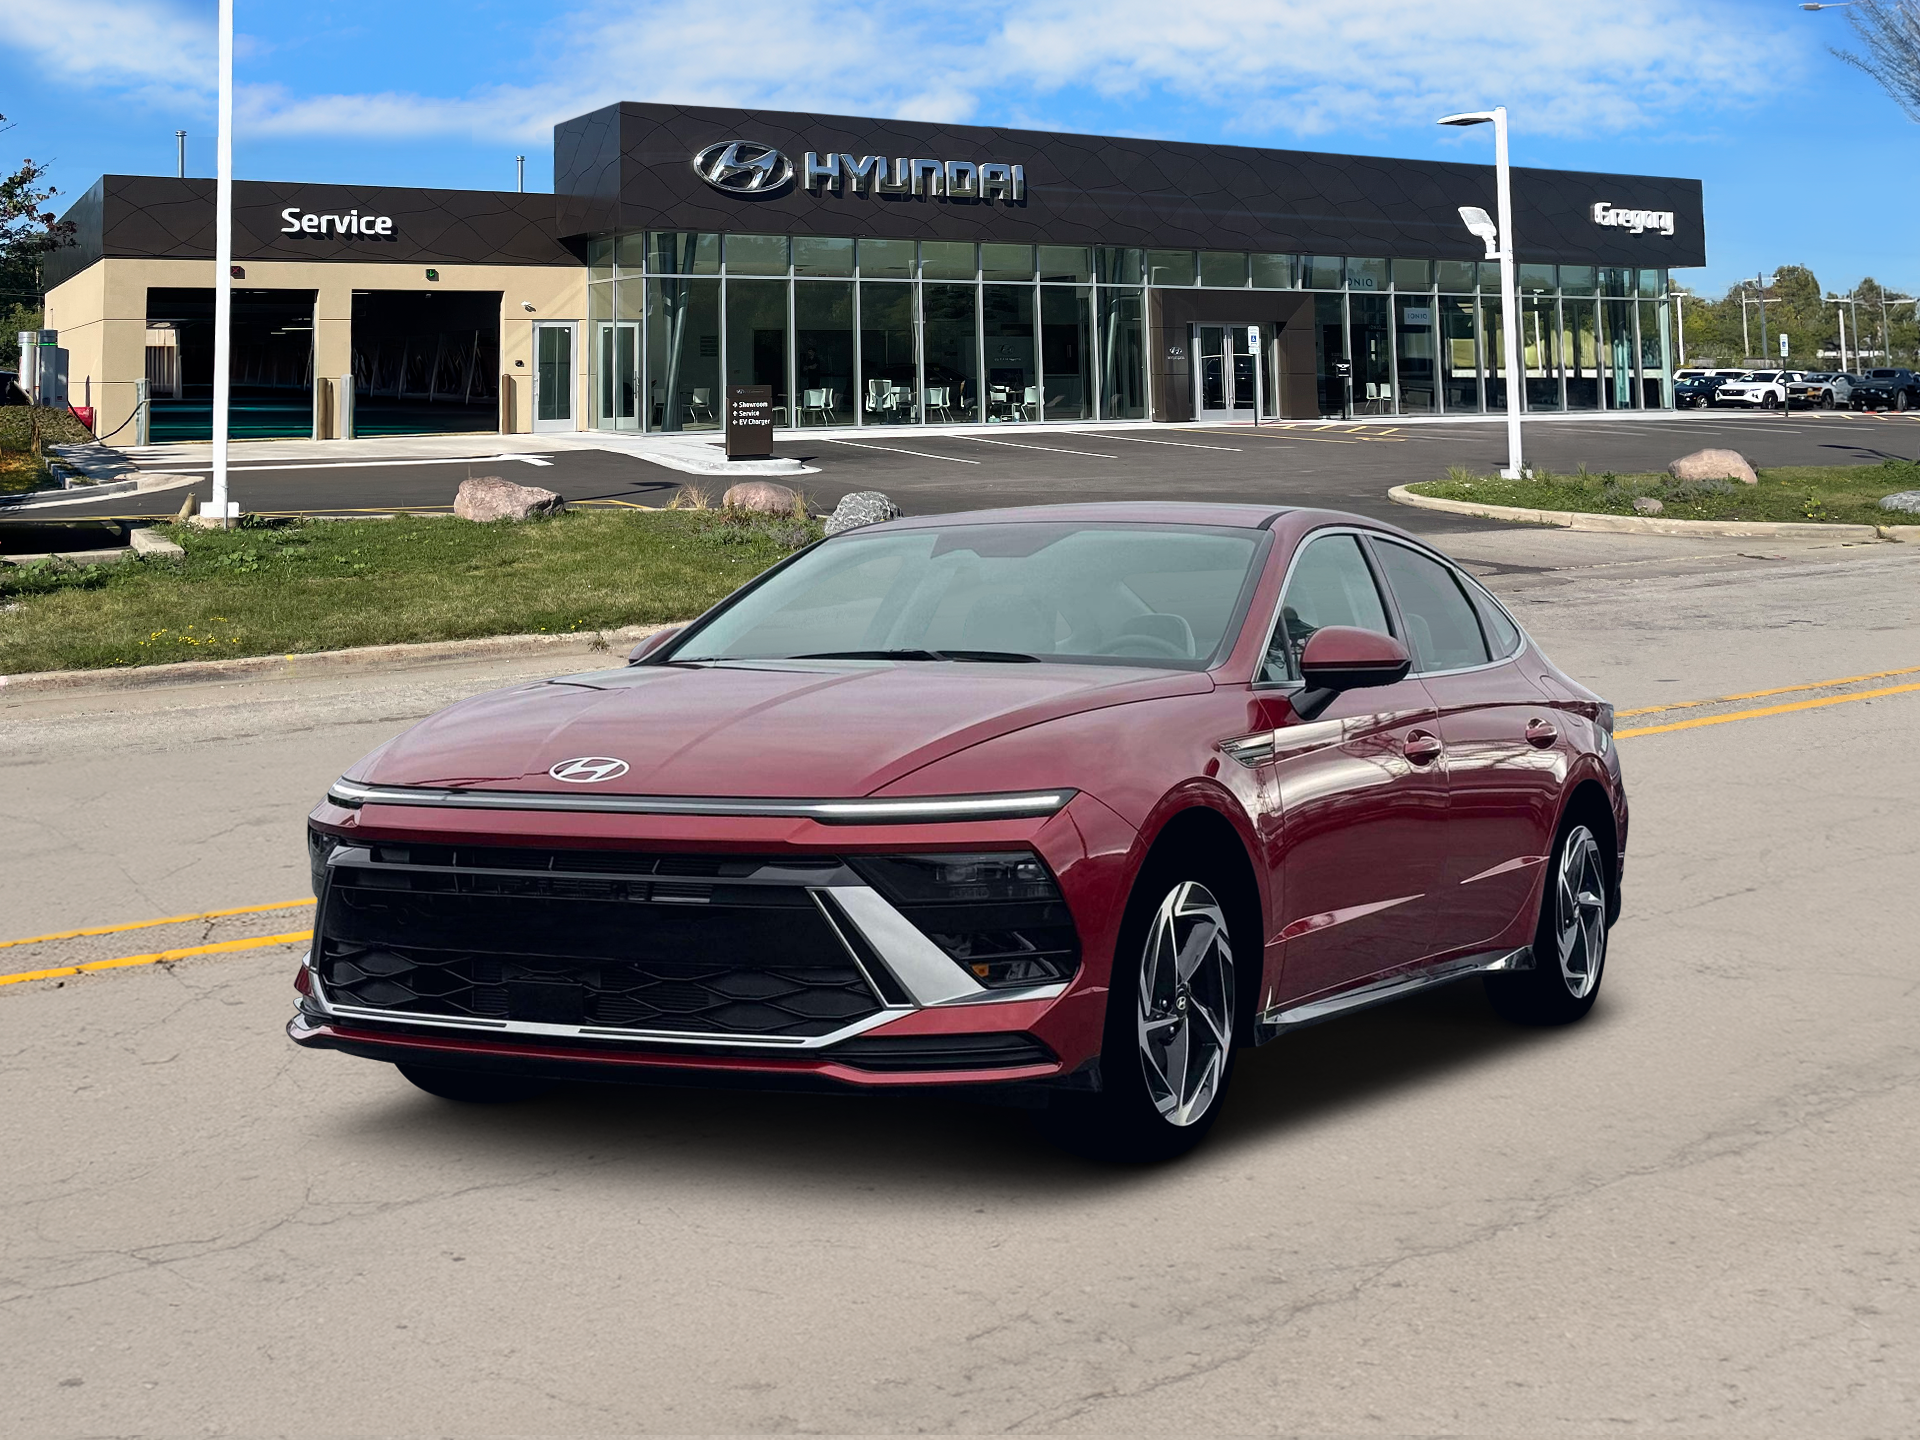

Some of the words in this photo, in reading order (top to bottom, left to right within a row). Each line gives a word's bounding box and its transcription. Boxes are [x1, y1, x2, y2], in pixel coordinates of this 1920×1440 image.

[804, 151, 1025, 200] HYUNDAI
[280, 207, 393, 235] Service
[1594, 202, 1674, 235] Gregory
[1347, 277, 1373, 287] ONIQ
[748, 418, 771, 426] Charger
